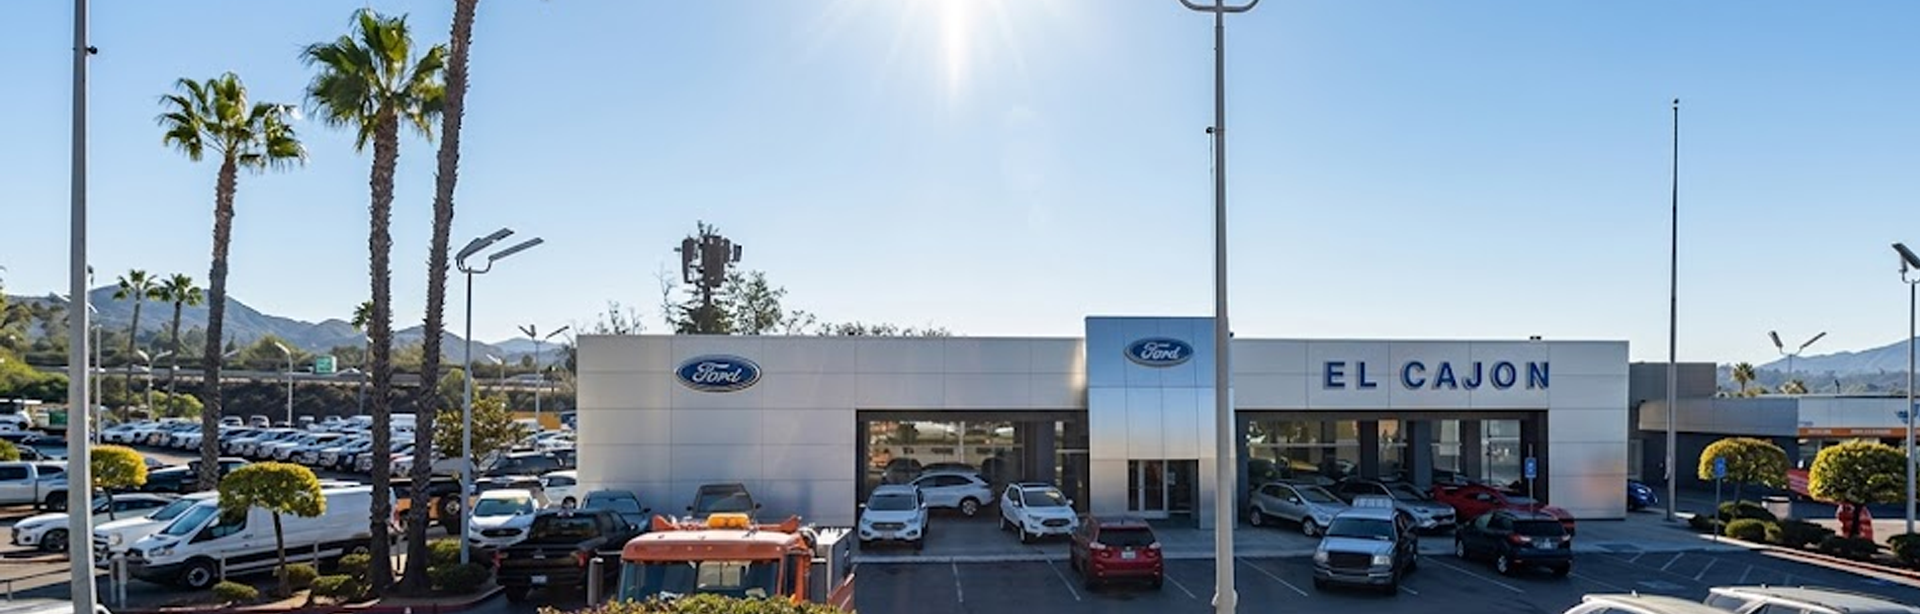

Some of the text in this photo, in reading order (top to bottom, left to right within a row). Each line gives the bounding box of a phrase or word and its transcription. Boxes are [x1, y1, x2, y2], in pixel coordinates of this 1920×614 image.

[1141, 342, 1181, 359] Ford
[692, 361, 743, 382] Ford
[1324, 361, 1549, 390] EL CAJON
